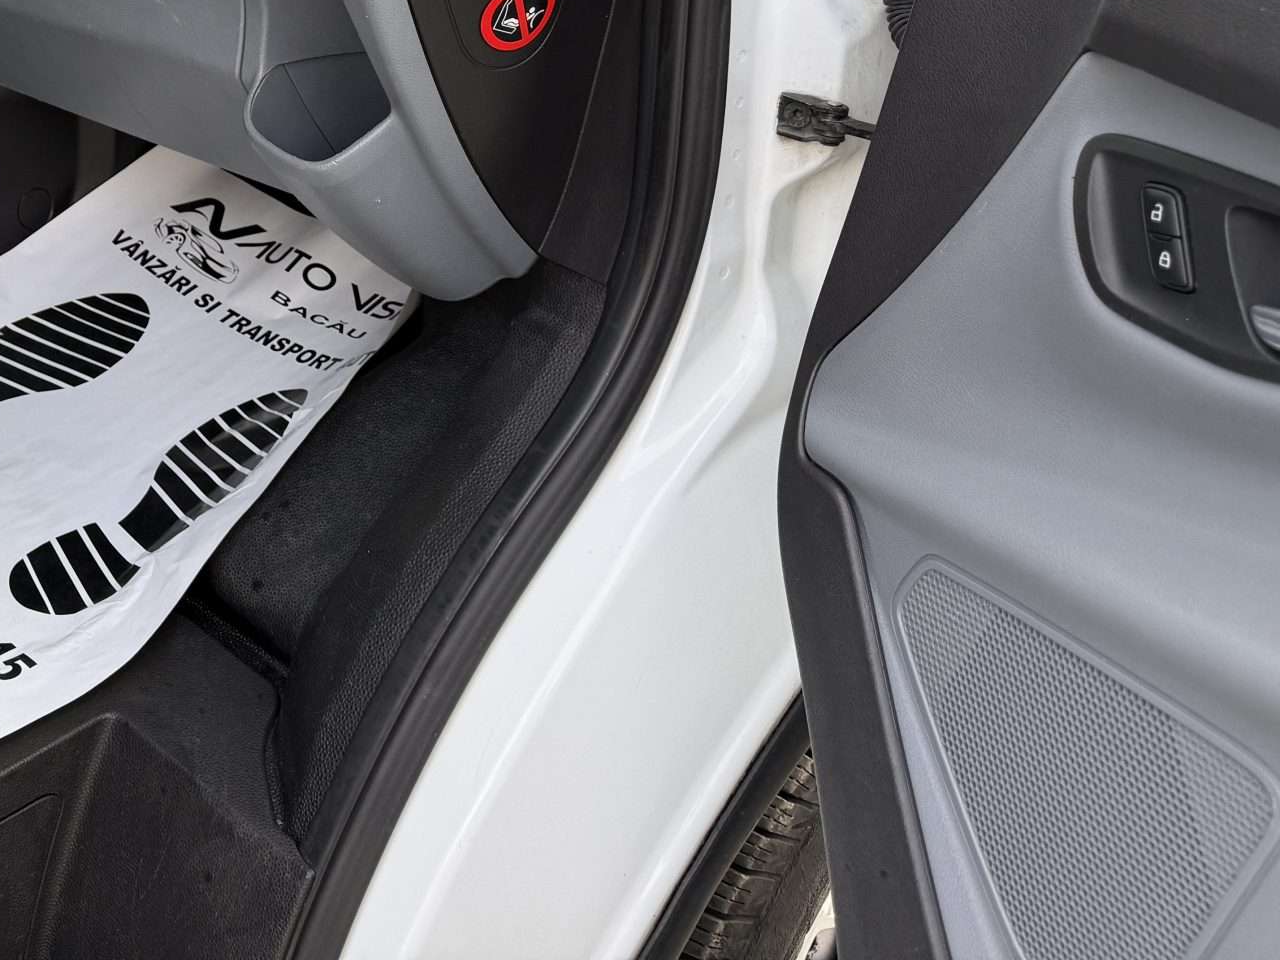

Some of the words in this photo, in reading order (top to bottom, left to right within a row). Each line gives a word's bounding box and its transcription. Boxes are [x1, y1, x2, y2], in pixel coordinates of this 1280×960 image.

[234, 240, 337, 291] AUTO
[112, 229, 198, 297] VÂNZĂRI
[219, 308, 344, 372] TRANSPORT
[270, 290, 368, 340] BACĂU
